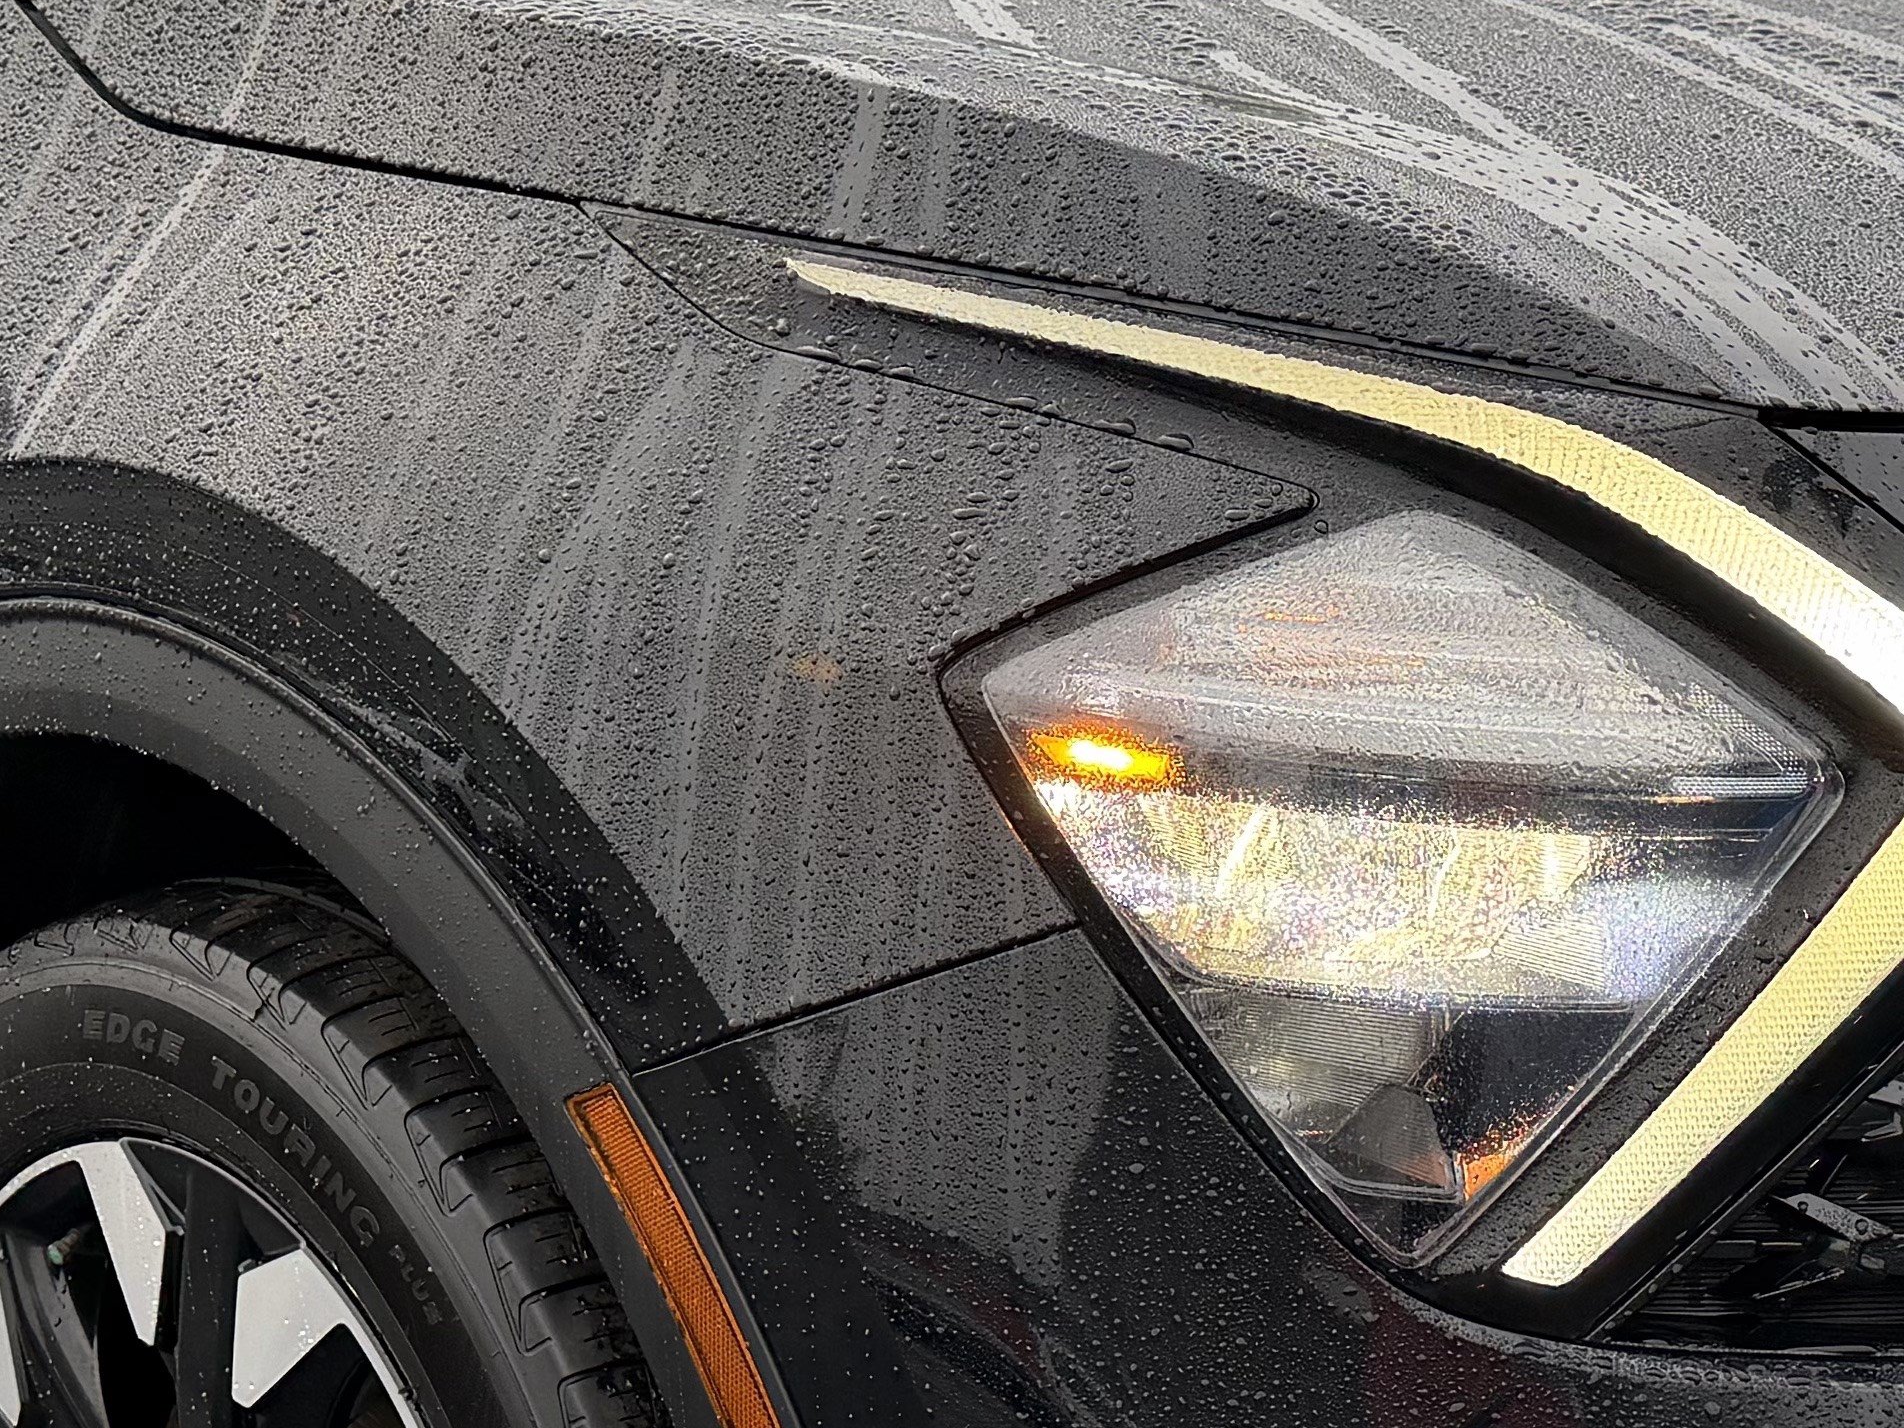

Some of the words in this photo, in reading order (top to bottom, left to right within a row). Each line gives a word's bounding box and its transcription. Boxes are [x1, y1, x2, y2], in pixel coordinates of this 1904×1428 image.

[82, 1008, 186, 1067] EDGE
[207, 1054, 380, 1249] TOURING
[388, 1244, 441, 1325] PLUS
